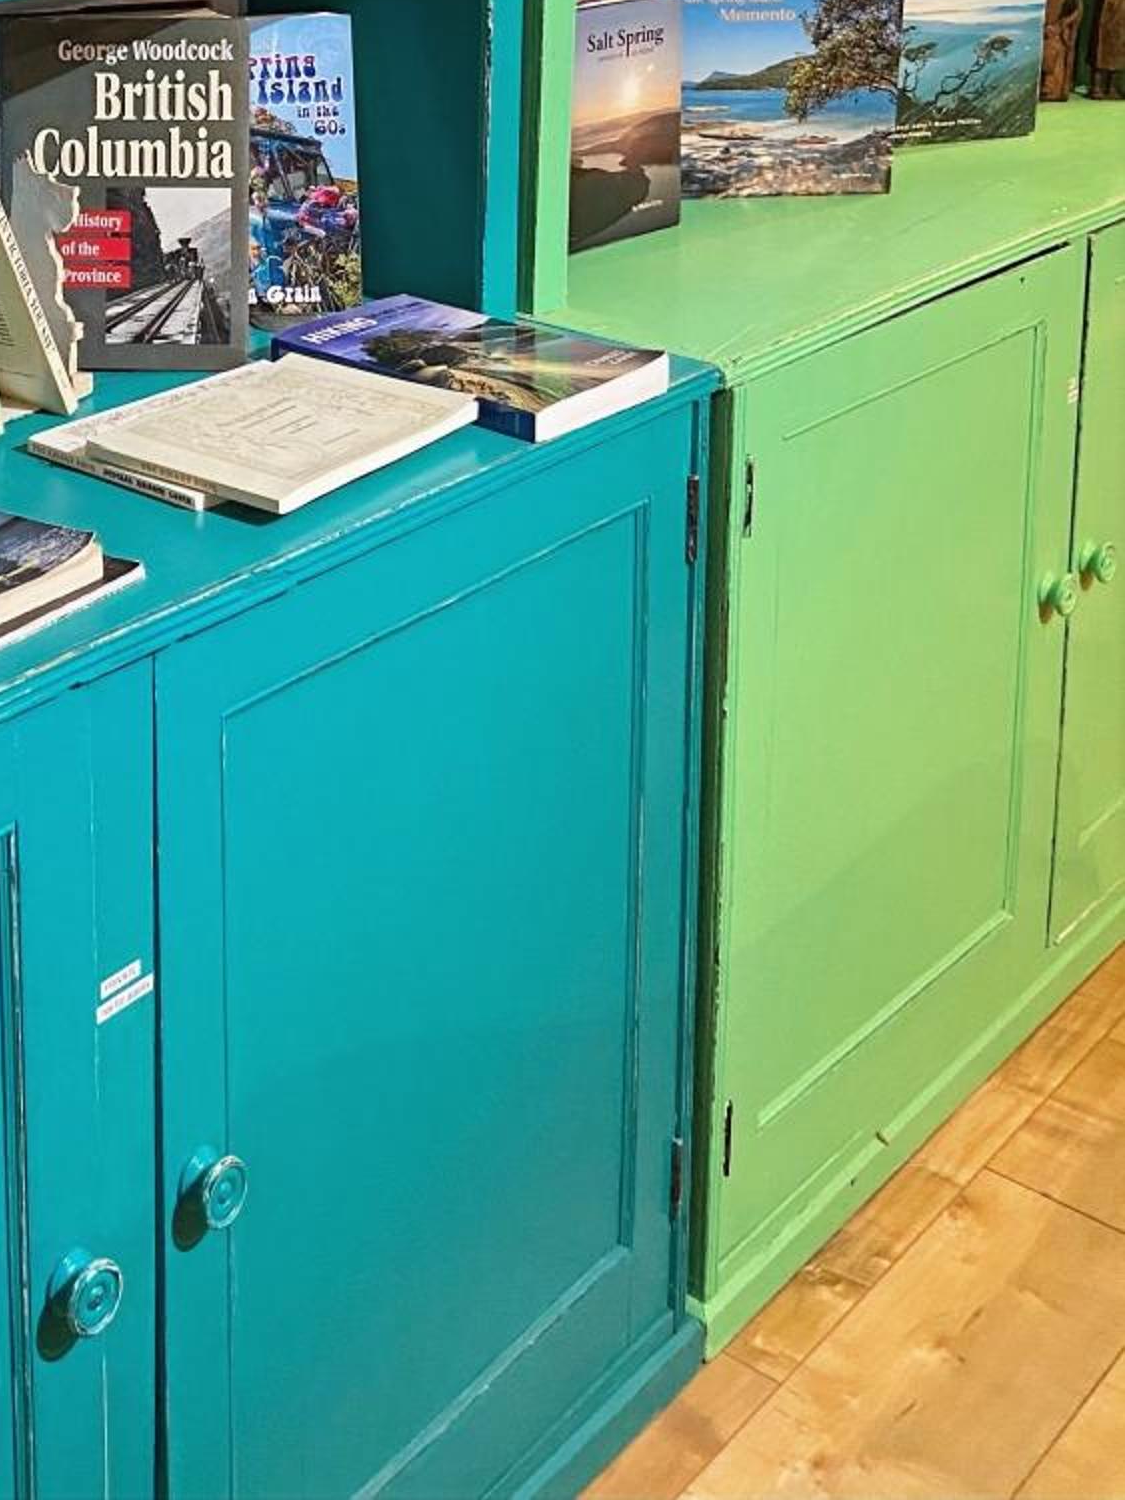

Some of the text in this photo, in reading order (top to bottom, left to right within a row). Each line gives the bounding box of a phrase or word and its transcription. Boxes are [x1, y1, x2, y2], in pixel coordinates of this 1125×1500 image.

[719, 7, 797, 22] Memento
[57, 38, 235, 66] George Woodcock
[587, 30, 614, 53] Salt
[617, 24, 665, 58] Spring
[93, 69, 235, 122] British
[257, 76, 344, 105] Island
[297, 104, 340, 118] in the
[31, 126, 236, 181] Columbia
[61, 241, 100, 256] of the
[266, 284, 322, 304] Grain
